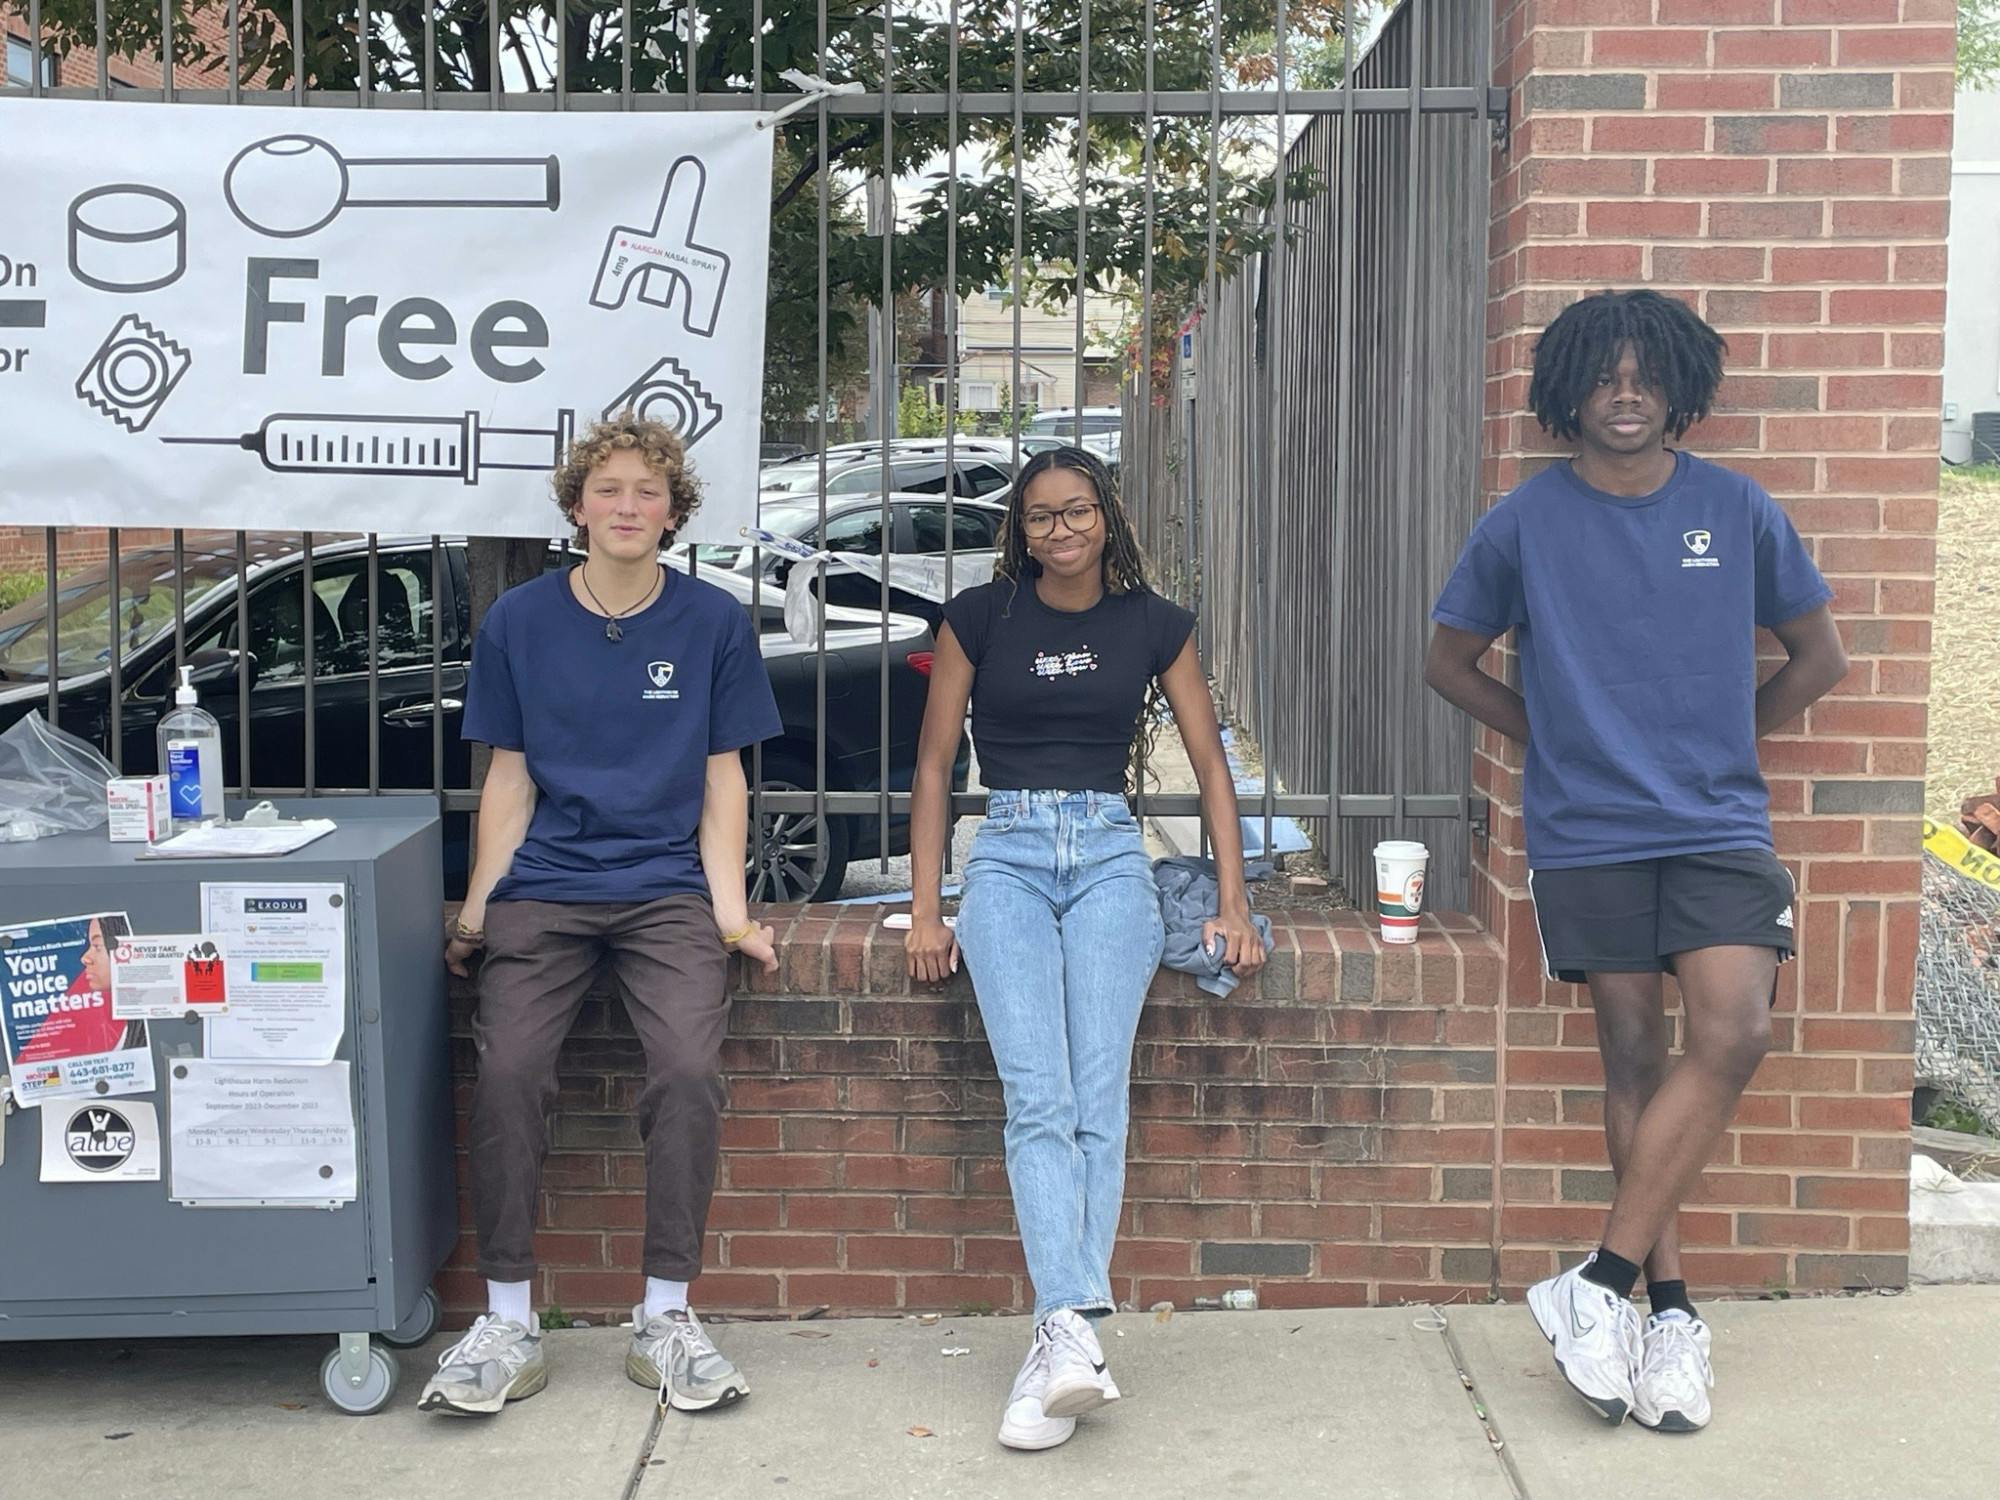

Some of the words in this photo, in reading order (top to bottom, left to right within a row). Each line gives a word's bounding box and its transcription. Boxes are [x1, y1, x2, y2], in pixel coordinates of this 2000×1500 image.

[630, 242, 664, 257] NARCAN
[663, 250, 690, 265] NASAL
[690, 258, 718, 273] SPRAY
[612, 255, 629, 277] 4mg
[243, 257, 549, 383] Free
[258, 901, 304, 910] EXODUS
[5, 954, 58, 976] Your
[8, 974, 68, 997] voice
[12, 991, 104, 1019] matters
[67, 1061, 82, 1069] CALL
[93, 1057, 109, 1065] TEXT
[21, 1081, 42, 1091] STEP
[214, 1078, 251, 1086] Lighthouse
[259, 1090, 295, 1098] Operation
[206, 1103, 243, 1111] September
[292, 1128, 324, 1136] Thursday
[326, 1128, 348, 1136] Friday
